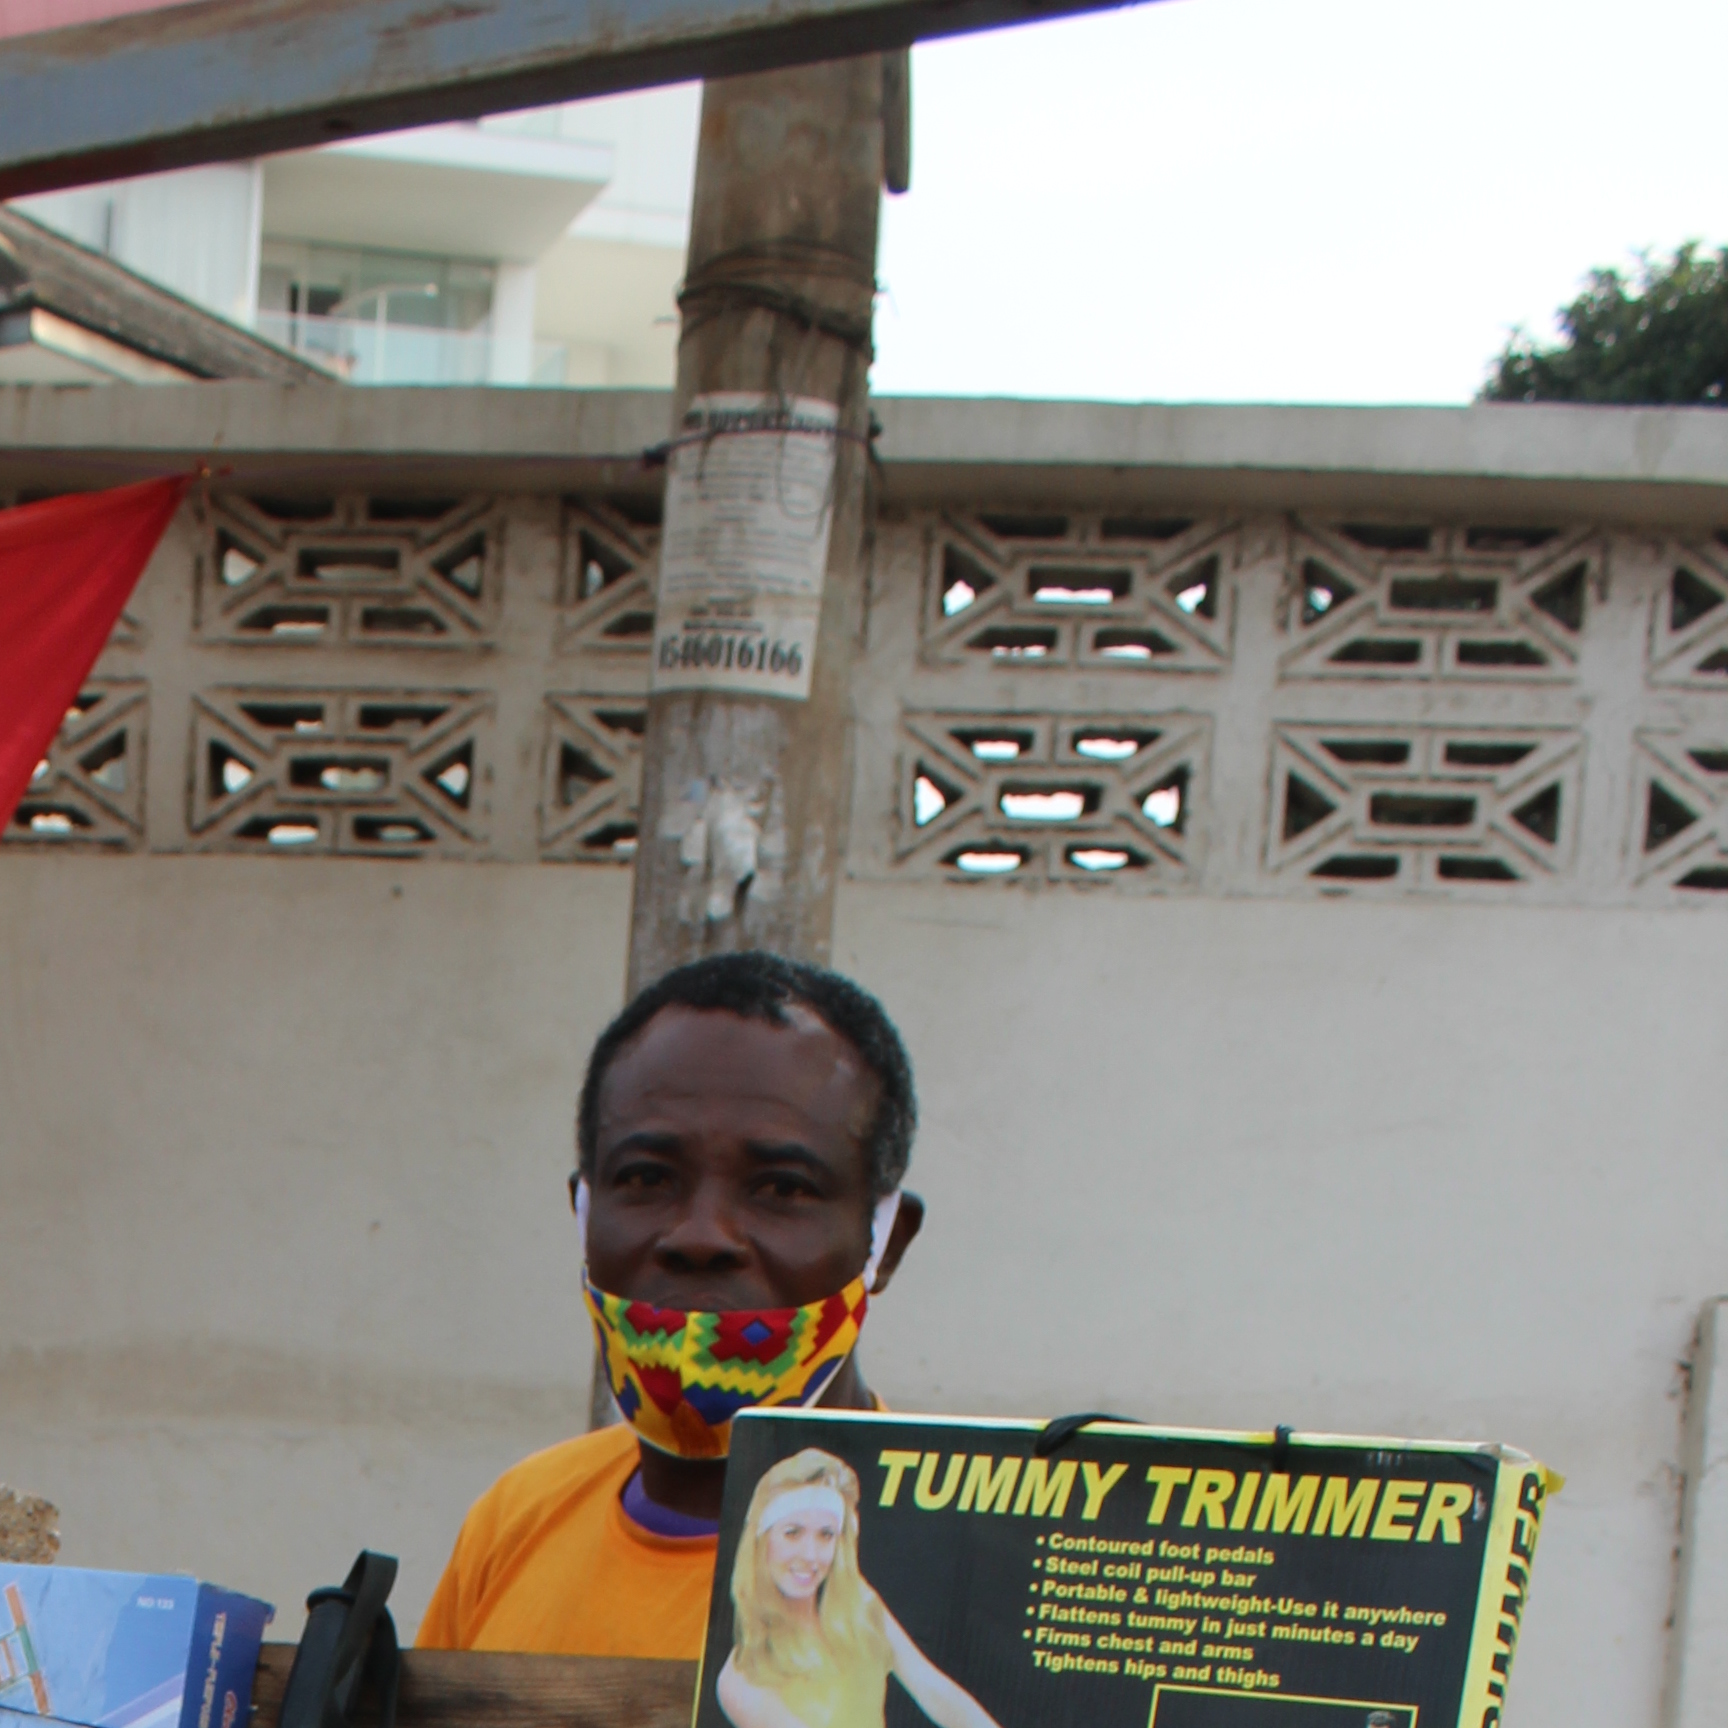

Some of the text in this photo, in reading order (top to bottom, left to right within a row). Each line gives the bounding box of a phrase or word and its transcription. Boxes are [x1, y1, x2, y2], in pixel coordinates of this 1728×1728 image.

[877, 1450, 1472, 1544] TUMMY TRIMMER
[1048, 1532, 1275, 1566] Contoured foot pedals
[1044, 1555, 1257, 1588] Steel coil pull-up bar
[1041, 1579, 1127, 1602] Portable
[1133, 1586, 1149, 1604] &
[1322, 1600, 1339, 1619] it
[1343, 1605, 1447, 1627] anywhere
[1034, 1627, 1254, 1661] Firms chest and arms
[1037, 1603, 1420, 1654] Flattens tummy in just minutes a day
[1032, 1650, 1281, 1689] Tightens hips and thighs
